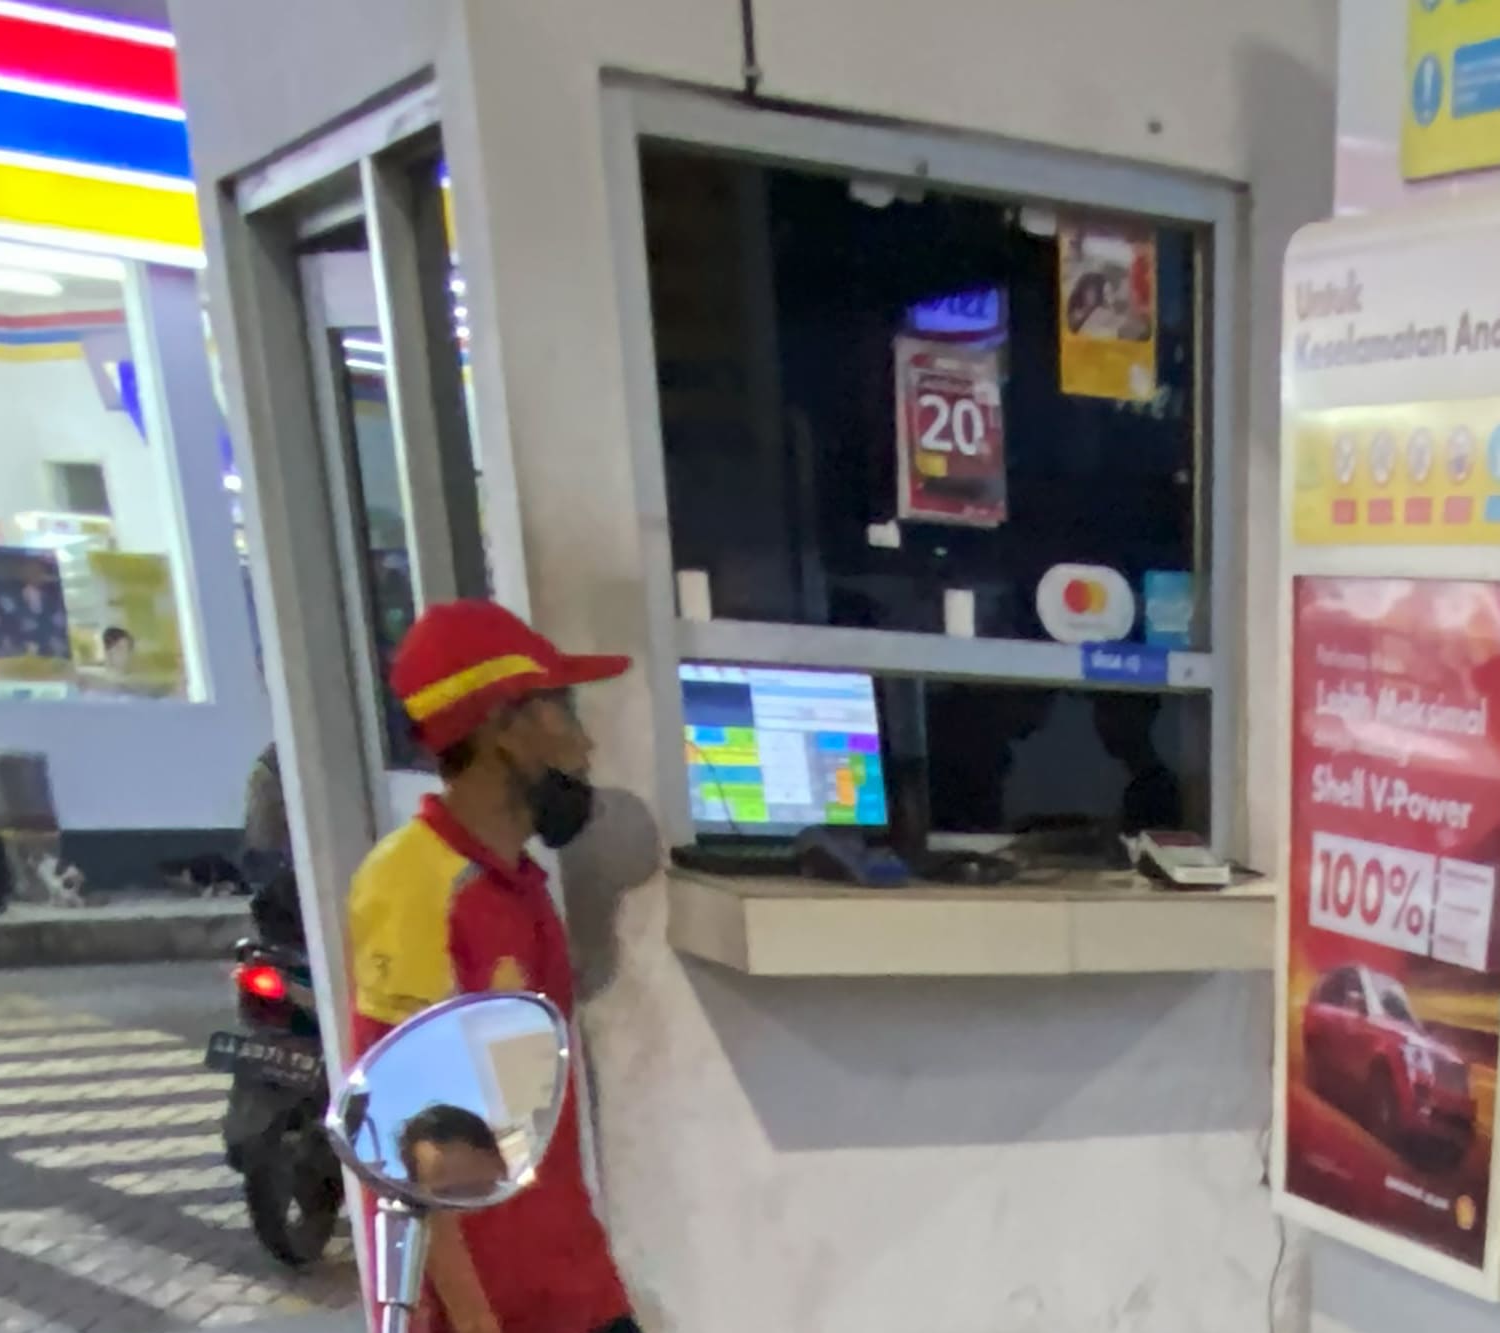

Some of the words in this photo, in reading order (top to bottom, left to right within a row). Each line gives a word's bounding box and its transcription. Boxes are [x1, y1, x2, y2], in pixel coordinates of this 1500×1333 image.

[920, 393, 985, 456] 20
[1312, 763, 1367, 810] Shell
[1368, 773, 1475, 830] V-Power
[1319, 849, 1425, 936] 100%
